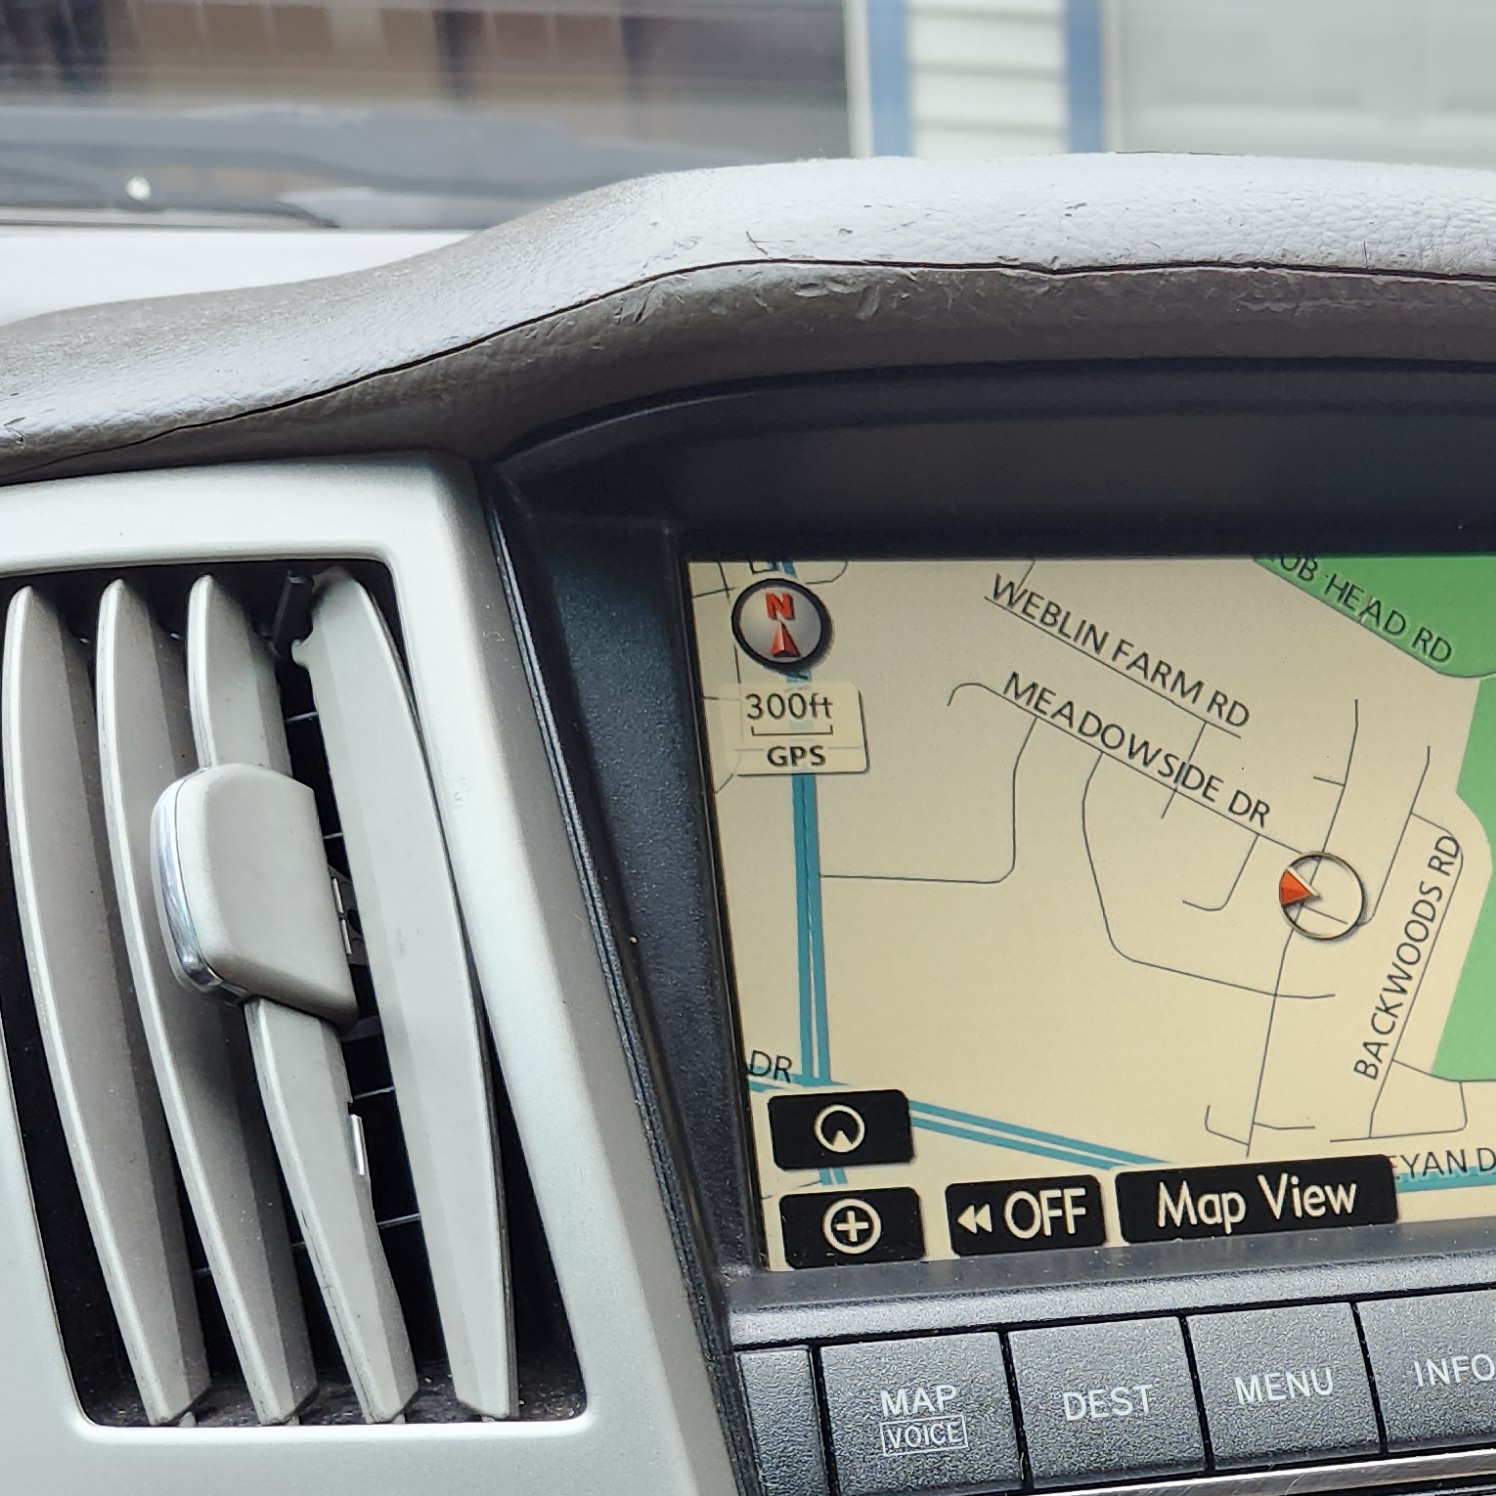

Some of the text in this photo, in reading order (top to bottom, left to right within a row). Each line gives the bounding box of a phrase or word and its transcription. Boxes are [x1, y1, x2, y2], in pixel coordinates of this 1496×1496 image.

[765, 592, 796, 621] N
[1269, 556, 1452, 663] OB HEAD RD
[992, 572, 1251, 729] WEBLIN FARM RD
[746, 693, 834, 721] 300ft
[766, 744, 826, 767] GPS
[1002, 671, 1272, 829] MEADOWSIDE DR
[1353, 834, 1462, 1081] BACKWOODS RD
[749, 1049, 793, 1084] DR
[1003, 1187, 1088, 1240] OFF
[1156, 1173, 1357, 1236] Map View
[1234, 1367, 1335, 1405] MENU
[1412, 1353, 1496, 1388] INFO
[880, 1384, 958, 1418] MAP
[1063, 1383, 1153, 1421] DEST
[886, 1422, 963, 1451] VOICE
